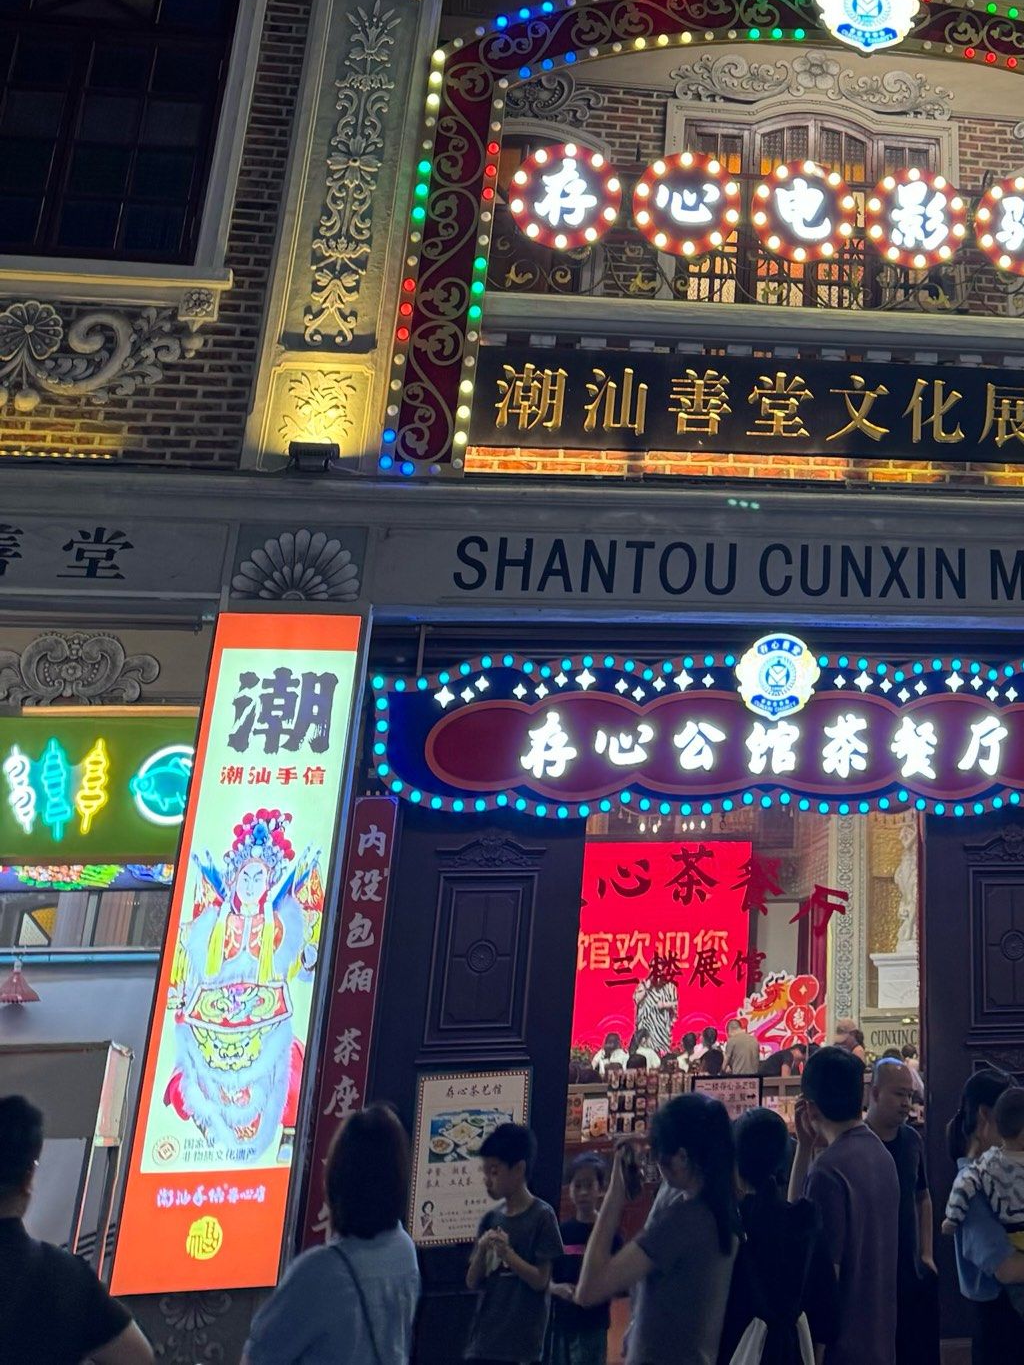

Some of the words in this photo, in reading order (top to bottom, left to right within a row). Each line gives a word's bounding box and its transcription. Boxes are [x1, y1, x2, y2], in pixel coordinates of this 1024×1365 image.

[453, 535, 737, 595] SHANTOU
[758, 543, 967, 601] CUNXIN
[227, 667, 339, 755] 潮
[520, 712, 1008, 779] 存心公馆茶餐厅
[220, 765, 326, 785] 潮汕手信
[338, 824, 387, 995] 内设包厢
[582, 845, 848, 936] 心茶餐厅
[323, 1029, 362, 1119] 茶座
[871, 1029, 909, 1046] CUNXIN
